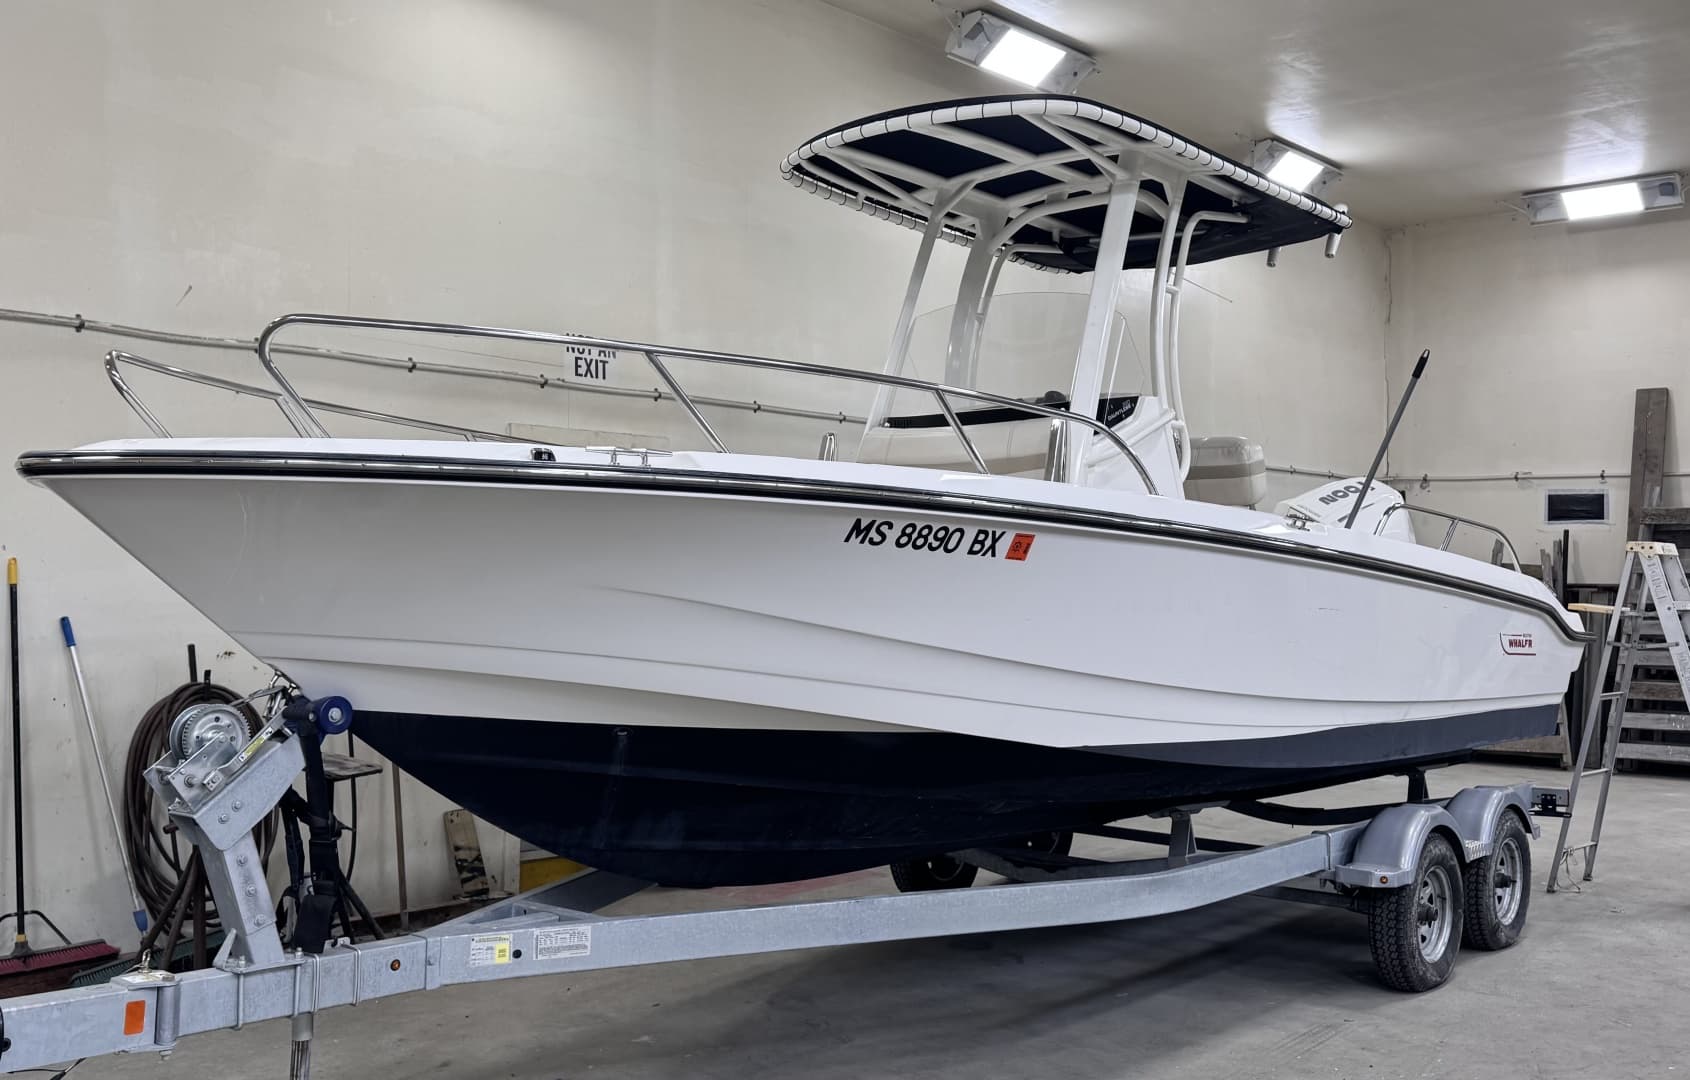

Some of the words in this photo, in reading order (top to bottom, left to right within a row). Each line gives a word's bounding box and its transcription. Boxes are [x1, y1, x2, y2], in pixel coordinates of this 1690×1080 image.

[574, 356, 609, 381] EXIT
[843, 517, 894, 547] MS
[895, 522, 965, 554] 8890
[967, 529, 1007, 558] BX
